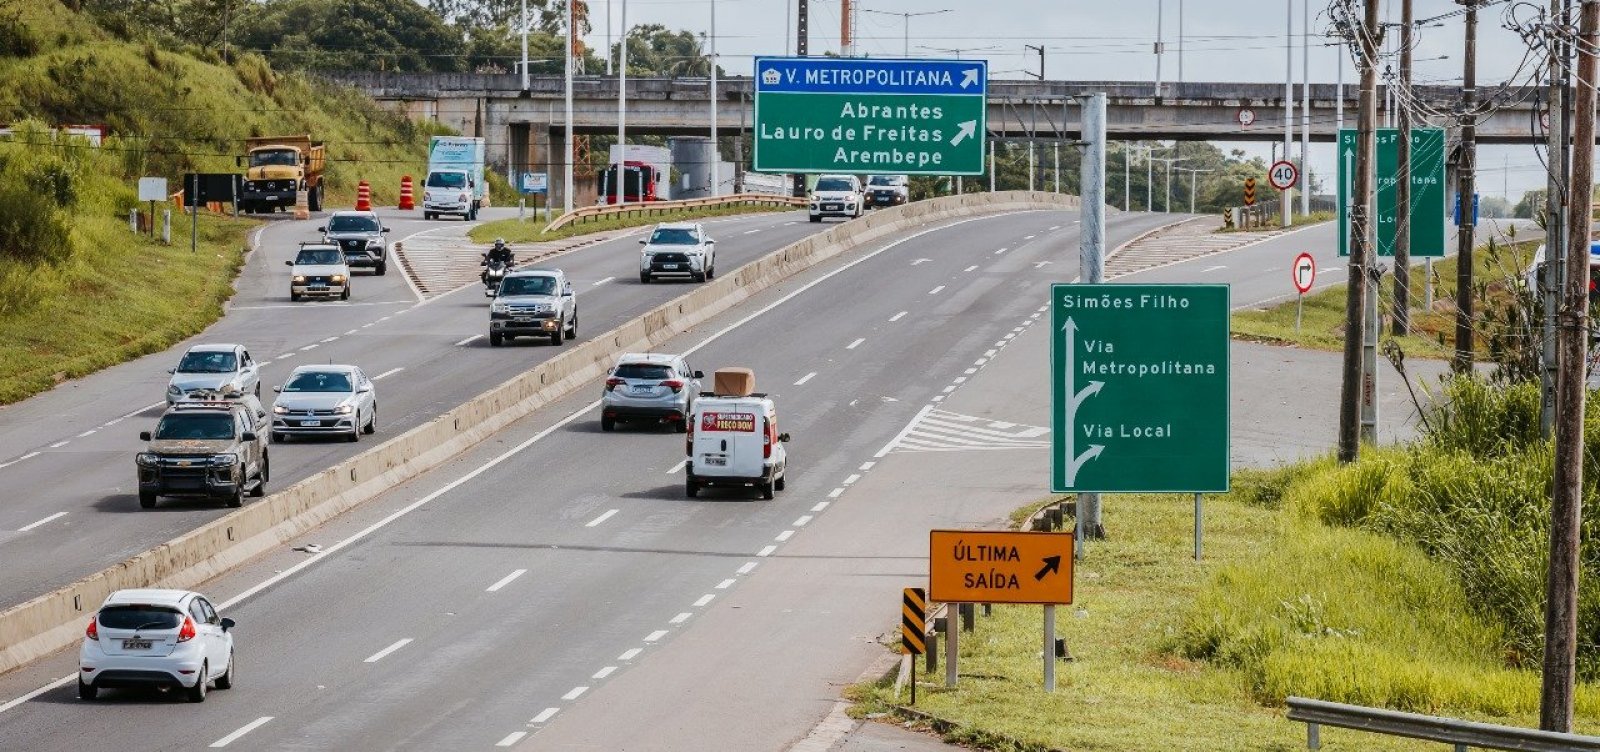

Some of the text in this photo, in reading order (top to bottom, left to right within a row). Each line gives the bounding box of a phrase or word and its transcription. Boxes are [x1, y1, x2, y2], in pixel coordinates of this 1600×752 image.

[786, 68, 953, 86] V. METROPOLITANA
[840, 102, 943, 120] Abrantes
[761, 124, 943, 142] Lauro de Freitas
[833, 147, 942, 168] Arembepe
[1274, 168, 1292, 180] 40
[1063, 294, 1190, 309] Simões Filho
[1084, 340, 1114, 353] Via
[1083, 361, 1215, 378] Metropolitana
[1083, 424, 1171, 438] Via Local
[953, 540, 1020, 562] ÚLTIMA
[964, 568, 1020, 590] SAÍDA
